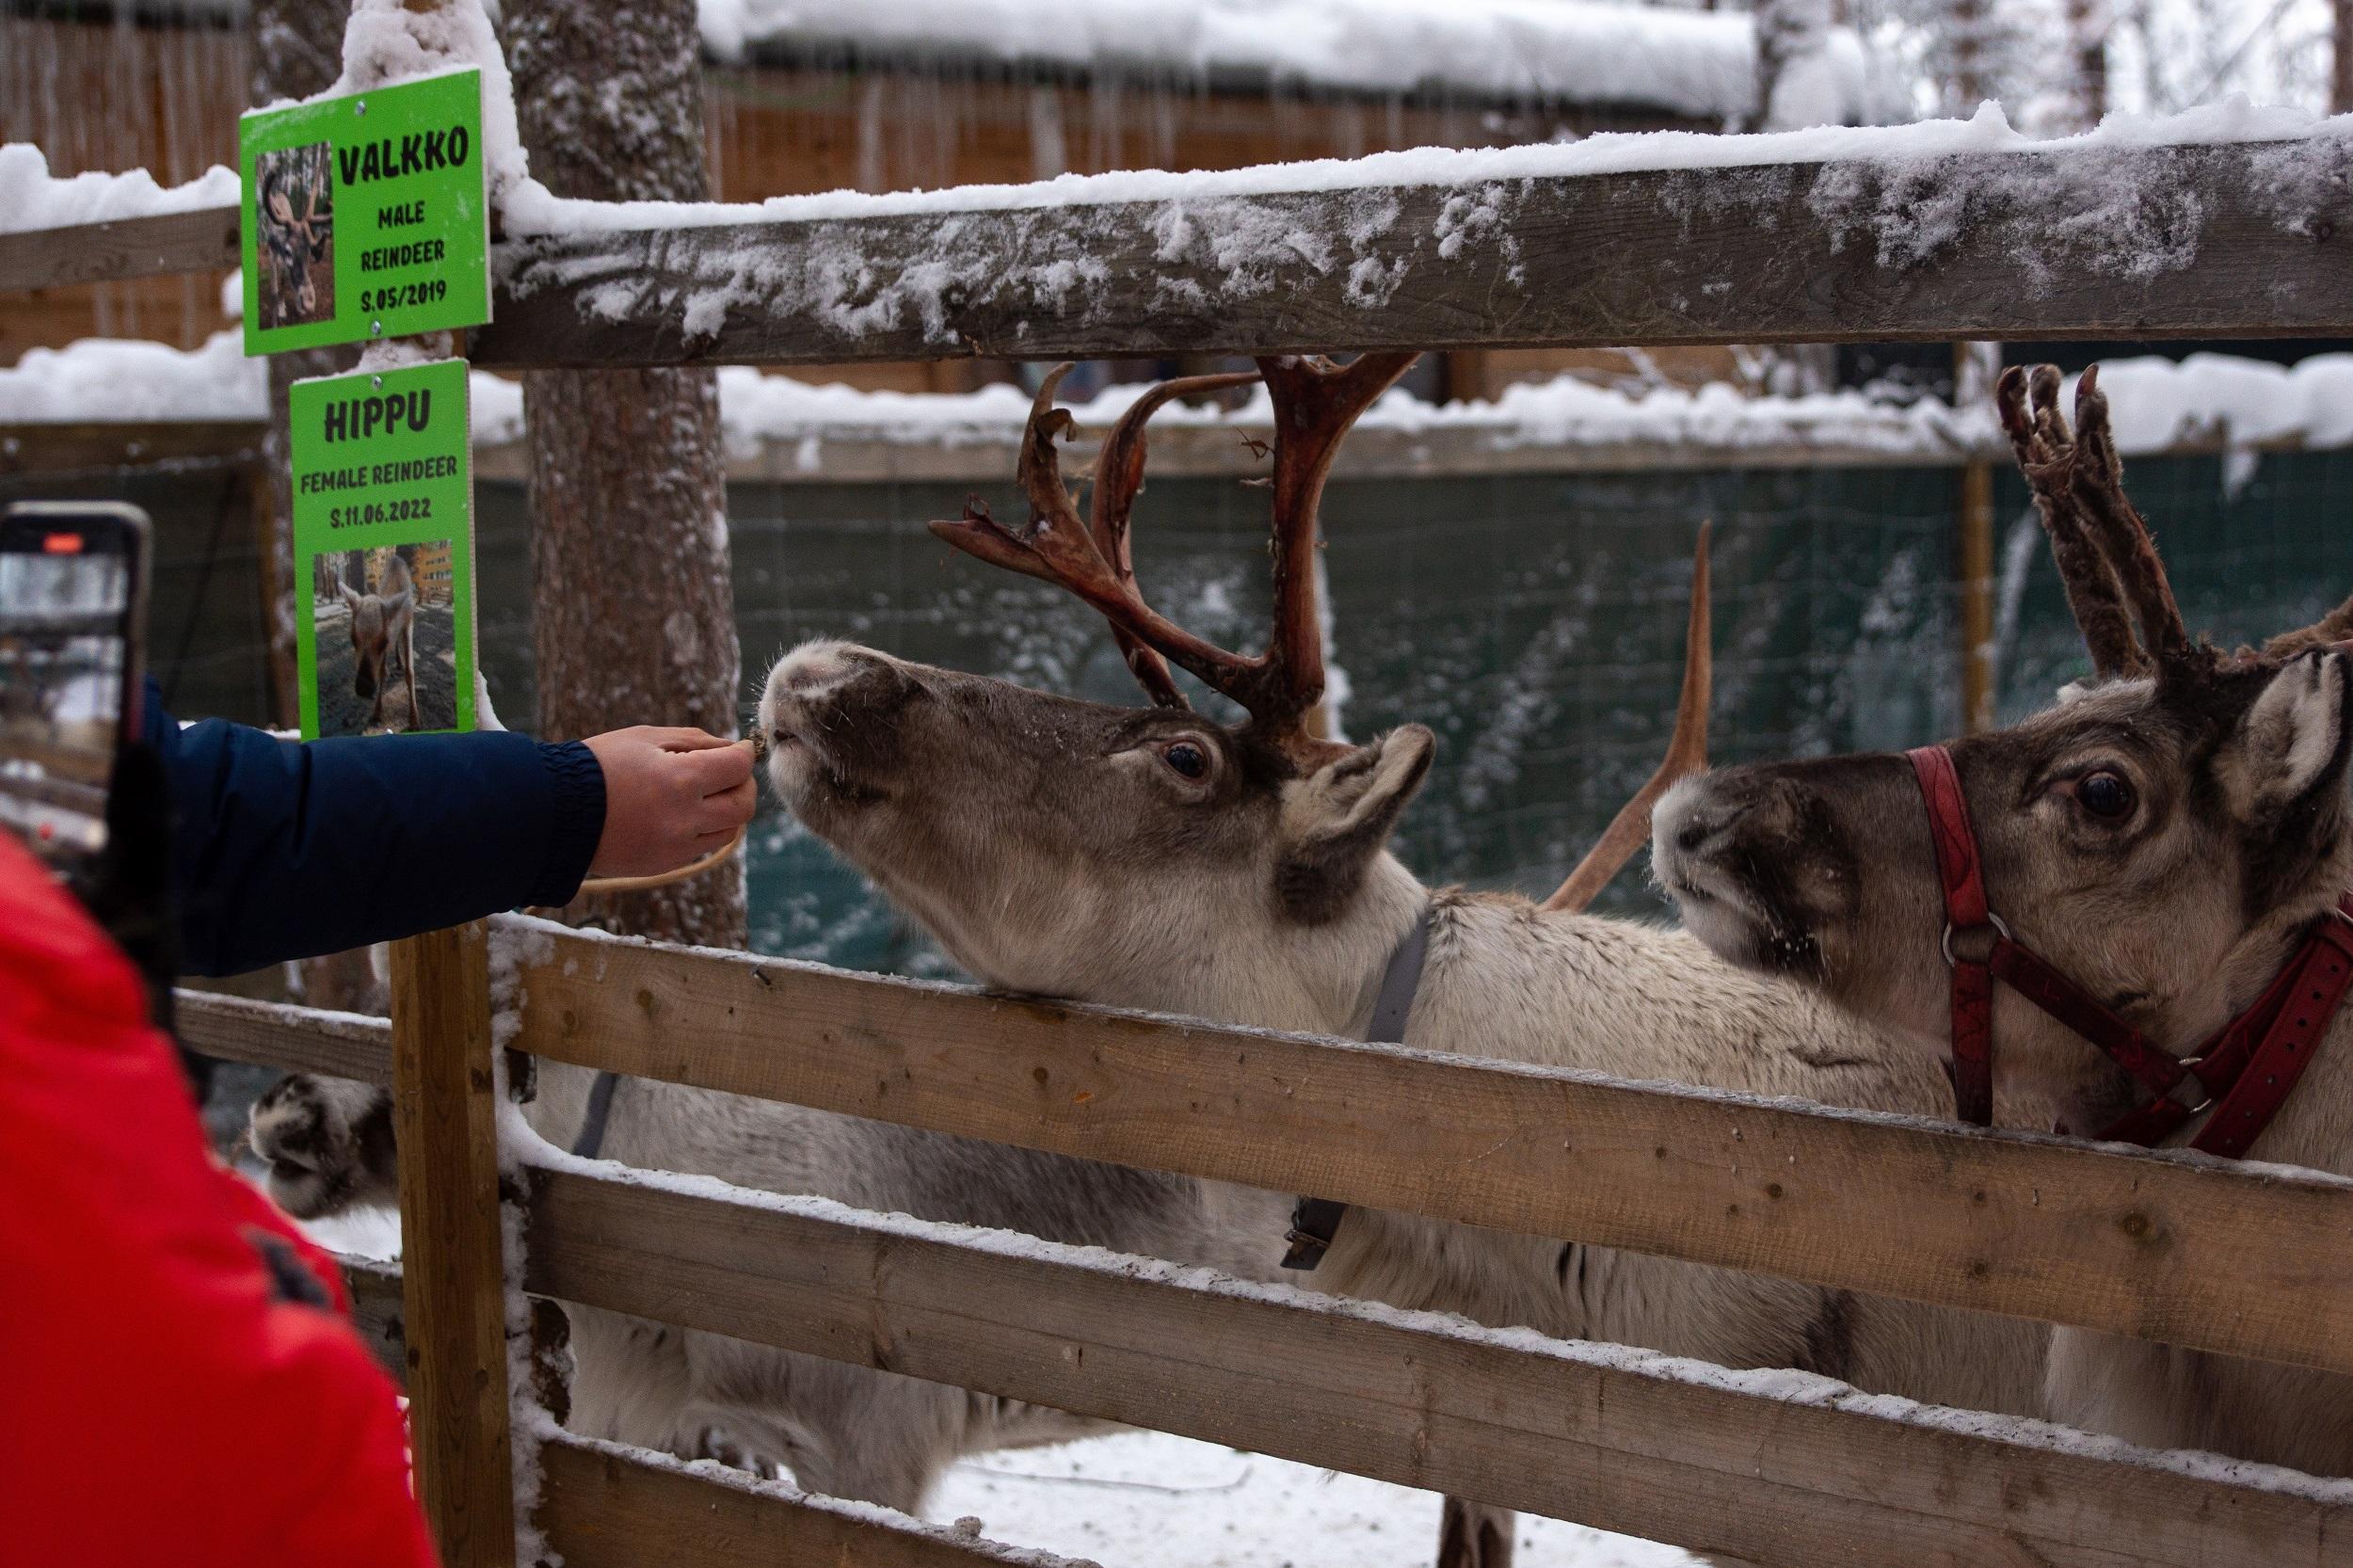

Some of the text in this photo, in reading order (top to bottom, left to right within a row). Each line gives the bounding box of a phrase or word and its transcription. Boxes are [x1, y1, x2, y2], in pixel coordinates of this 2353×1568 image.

[339, 125, 469, 185] VALKKO
[377, 200, 425, 230] MALE
[360, 238, 445, 272] REINDEER
[360, 279, 447, 313] S.05/2019
[324, 389, 431, 443] HIPPU
[300, 455, 457, 494] FEMALE REINDEER
[329, 497, 432, 529] S.11.06.2022
